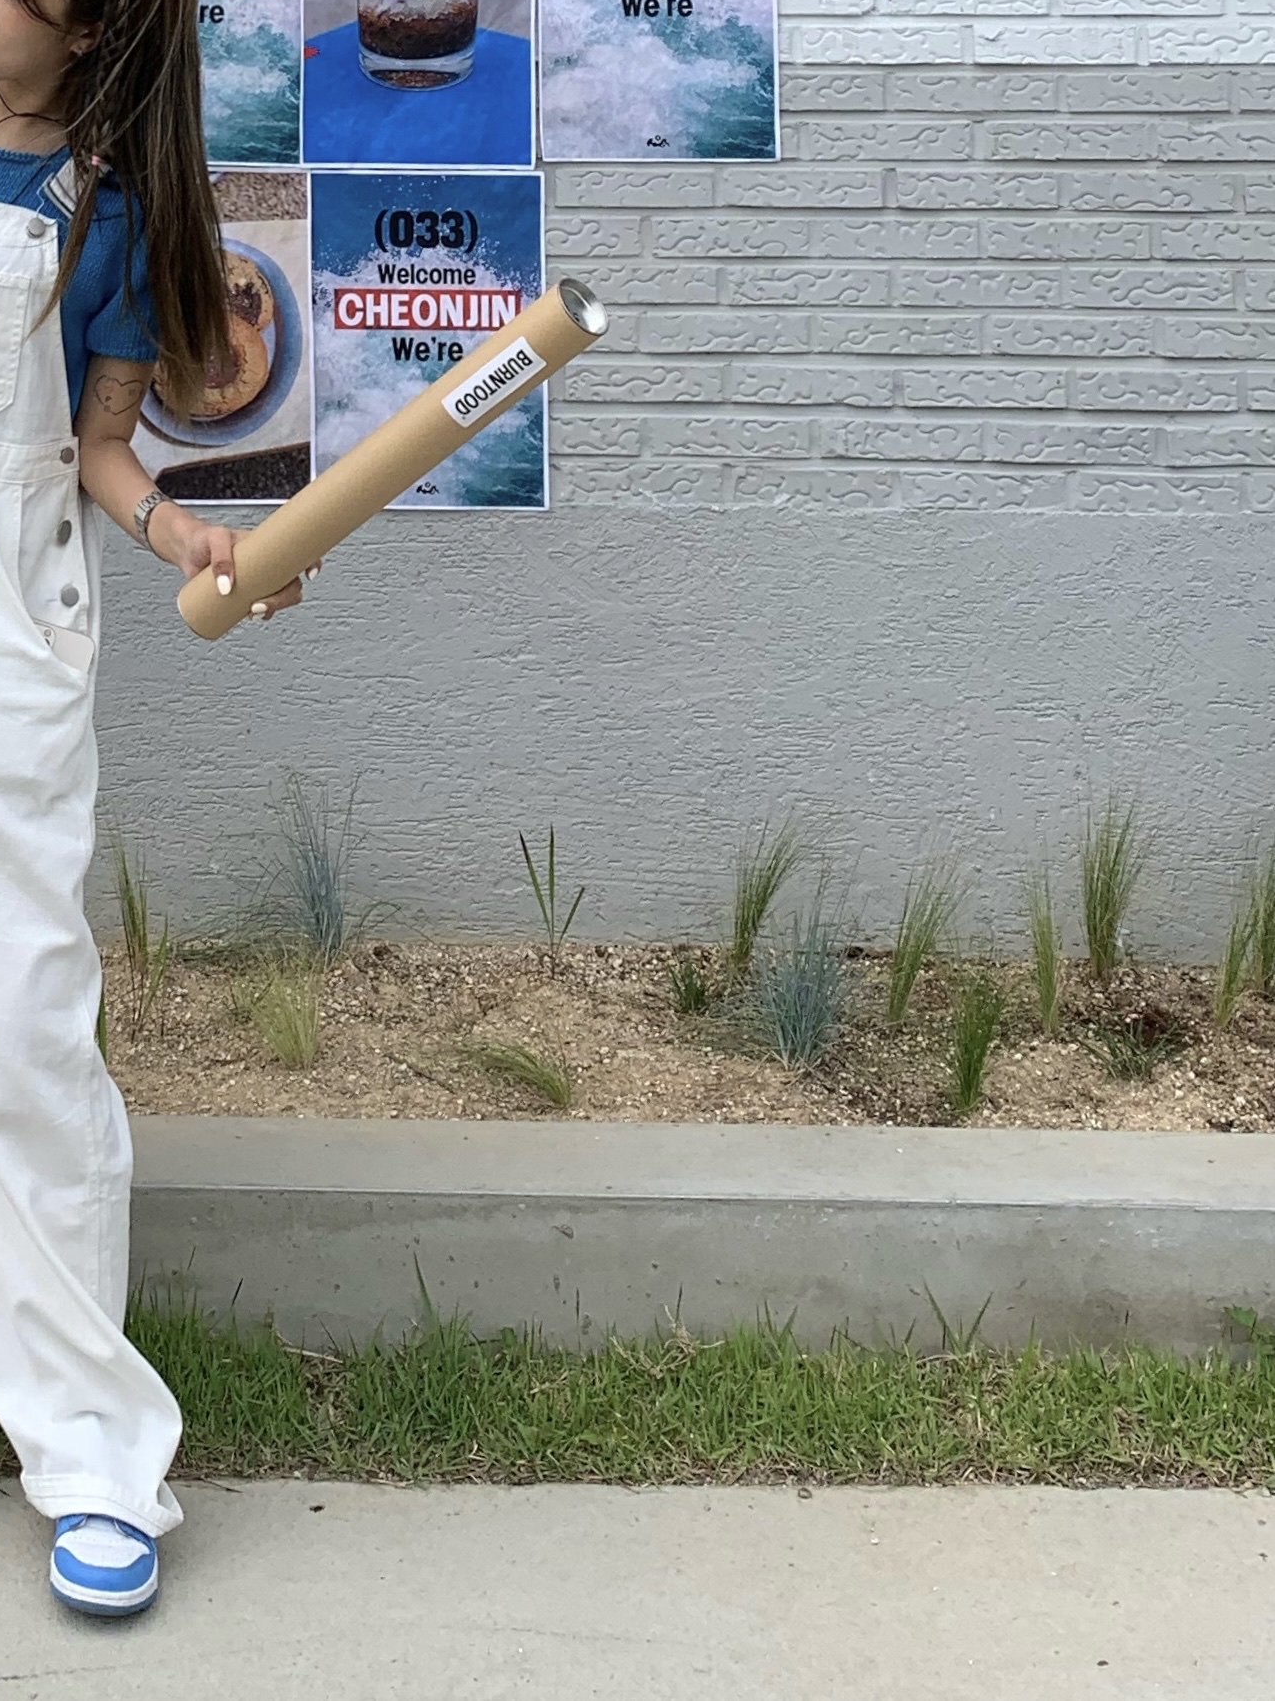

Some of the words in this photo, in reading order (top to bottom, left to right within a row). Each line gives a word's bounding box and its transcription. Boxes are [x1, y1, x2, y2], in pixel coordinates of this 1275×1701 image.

[374, 208, 479, 253] (033)
[377, 263, 476, 286] Welcome
[338, 292, 518, 328] CHEONJIN
[392, 336, 464, 362] We're
